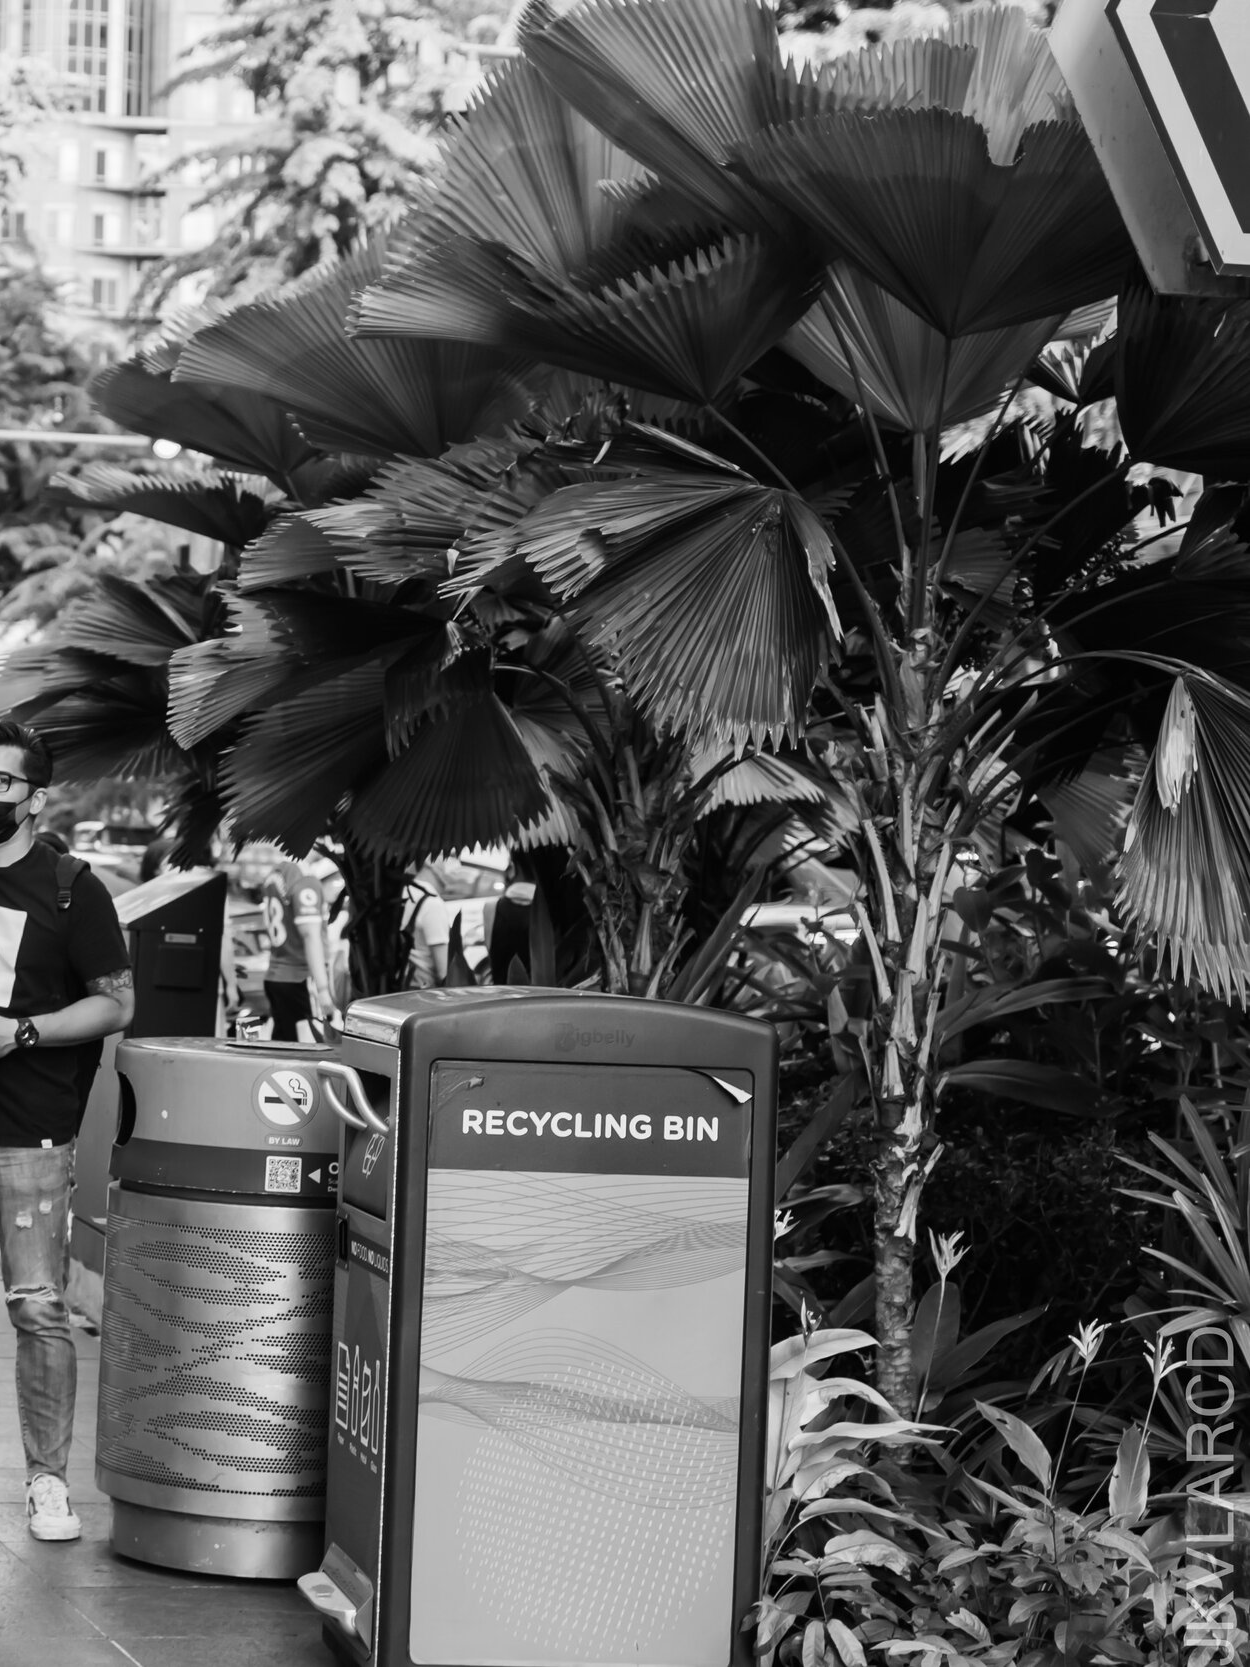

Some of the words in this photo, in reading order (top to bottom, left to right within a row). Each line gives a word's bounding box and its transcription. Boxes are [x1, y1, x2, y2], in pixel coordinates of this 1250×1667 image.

[462, 1109, 652, 1140] RECYCLING
[663, 1115, 719, 1142] BIN
[268, 1136, 281, 1145] BY
[281, 1137, 301, 1146] LAW
